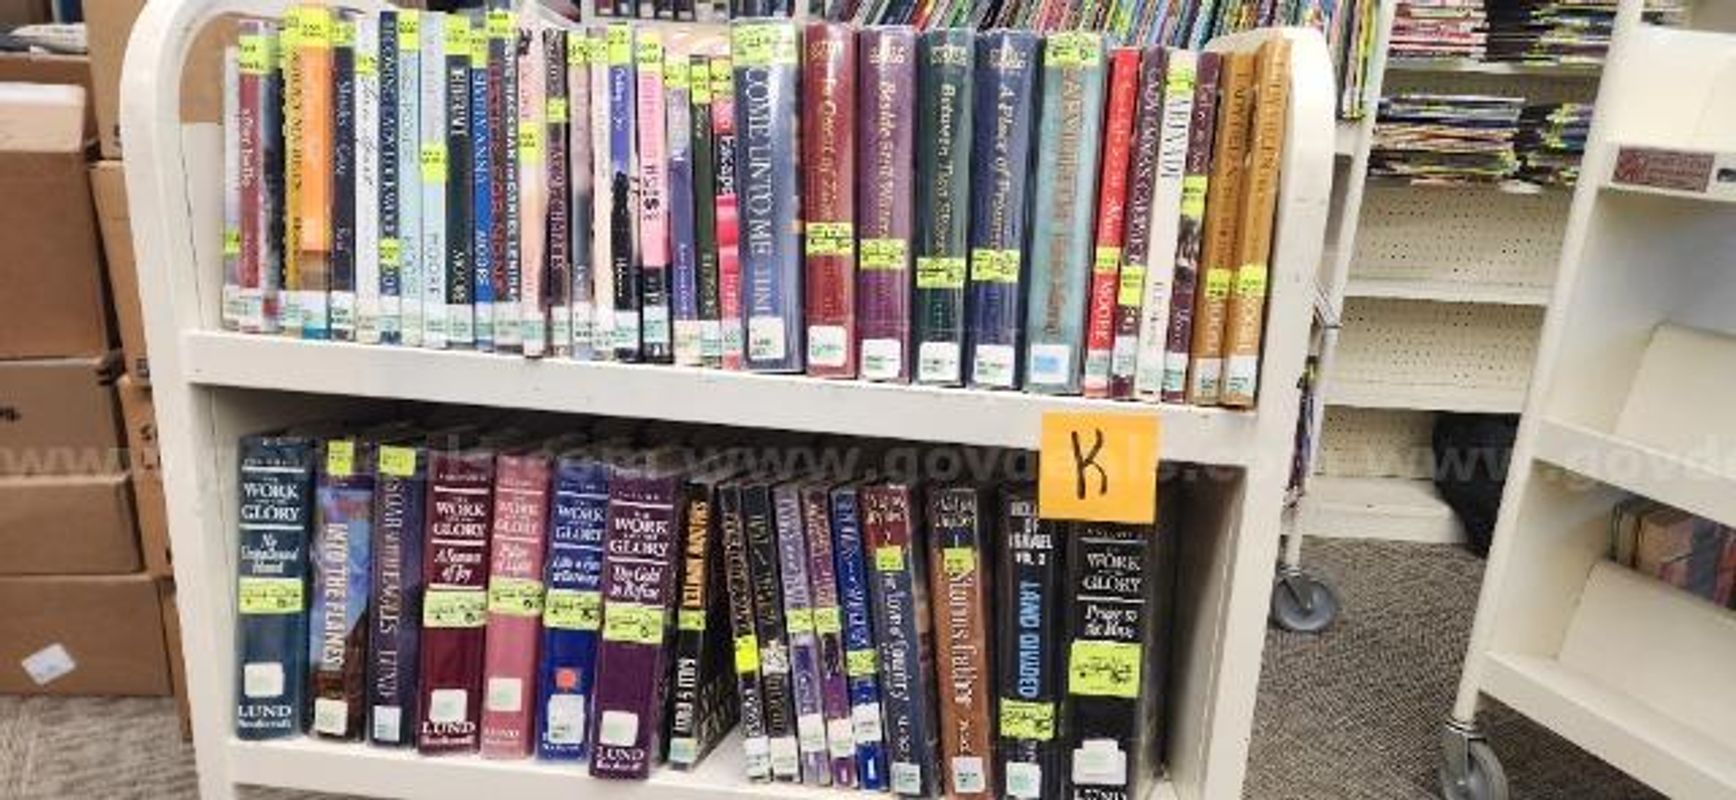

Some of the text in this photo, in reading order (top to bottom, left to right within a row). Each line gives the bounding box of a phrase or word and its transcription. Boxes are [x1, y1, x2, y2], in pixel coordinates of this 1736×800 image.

[878, 81, 897, 137] Beside
[1000, 84, 1015, 97] A
[505, 83, 516, 159] HACKMAN
[823, 100, 837, 152] Quest
[938, 83, 956, 157] Between
[996, 102, 1014, 152] Place
[1160, 98, 1189, 178] ABINADI
[240, 149, 254, 188] hello
[474, 133, 488, 183] ANNA
[719, 135, 736, 195] Escape
[746, 69, 772, 255] COME UNTO ME
[491, 164, 504, 214] FOR
[507, 181, 518, 236] DANIEL
[475, 230, 490, 286] MOORE
[493, 222, 507, 293] NONE
[1094, 280, 1113, 342] MOORE
[1071, 428, 1108, 500] K
[243, 481, 300, 499] WORK
[435, 501, 487, 517] WORK
[499, 501, 540, 515] WORK
[240, 504, 300, 521] GLORY
[433, 523, 487, 538] GLORY
[494, 517, 538, 534] GLORY
[555, 525, 604, 542] GLORY
[558, 505, 604, 521] WORK
[614, 517, 670, 534] WORK
[685, 500, 711, 556] SHADOW
[609, 539, 671, 557] GLORY
[1008, 533, 1053, 549] ISRAEL
[1086, 552, 1142, 571] WORK
[323, 522, 349, 665] INTO THE FLAMES
[1082, 575, 1143, 593] GLORY
[1017, 581, 1041, 699] LAND DIVIDED
[237, 703, 293, 718] LUND
[421, 720, 476, 735] LUND
[596, 746, 645, 761] LUND
